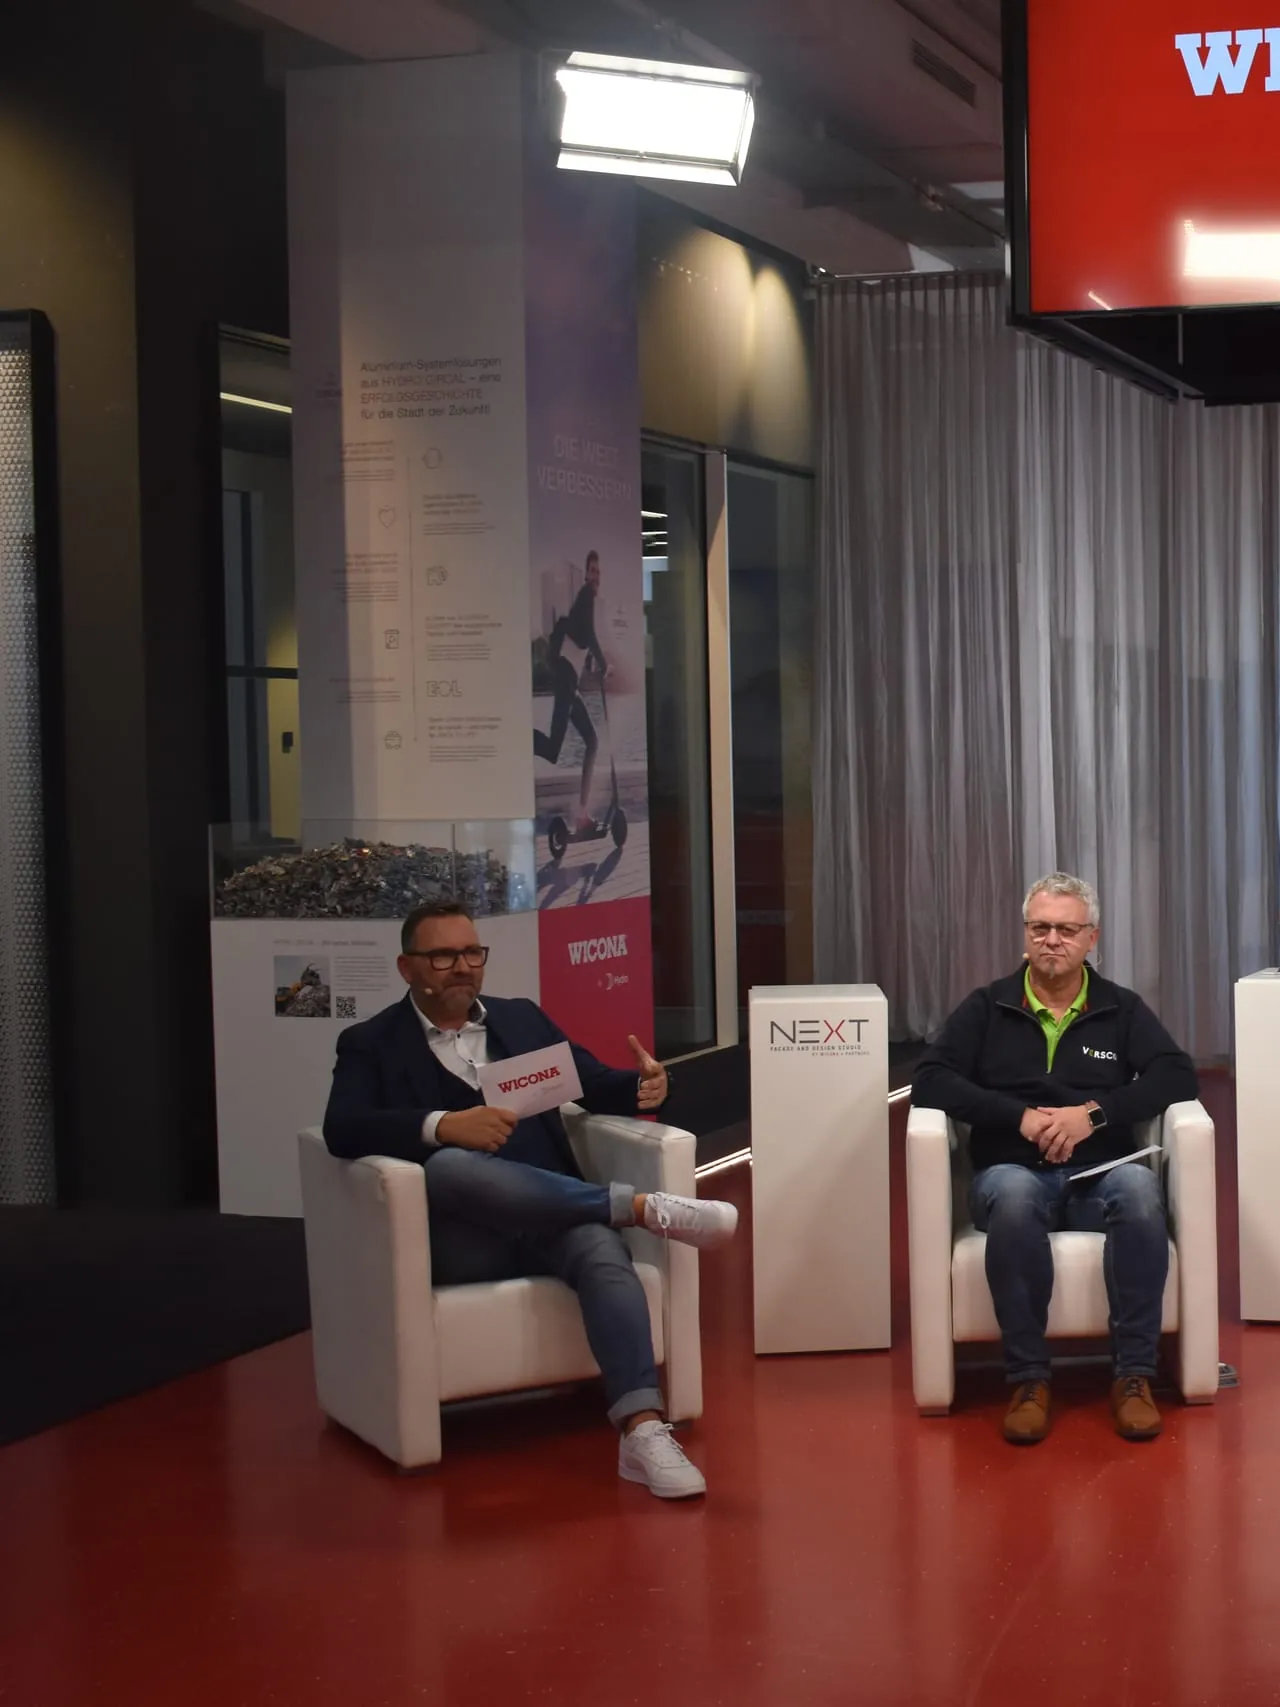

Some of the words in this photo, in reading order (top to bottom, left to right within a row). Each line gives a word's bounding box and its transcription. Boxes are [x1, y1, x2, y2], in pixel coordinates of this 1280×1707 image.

[567, 934, 628, 966] WICONA
[770, 1019, 870, 1044] NEXT
[497, 1066, 561, 1094] WICONA
